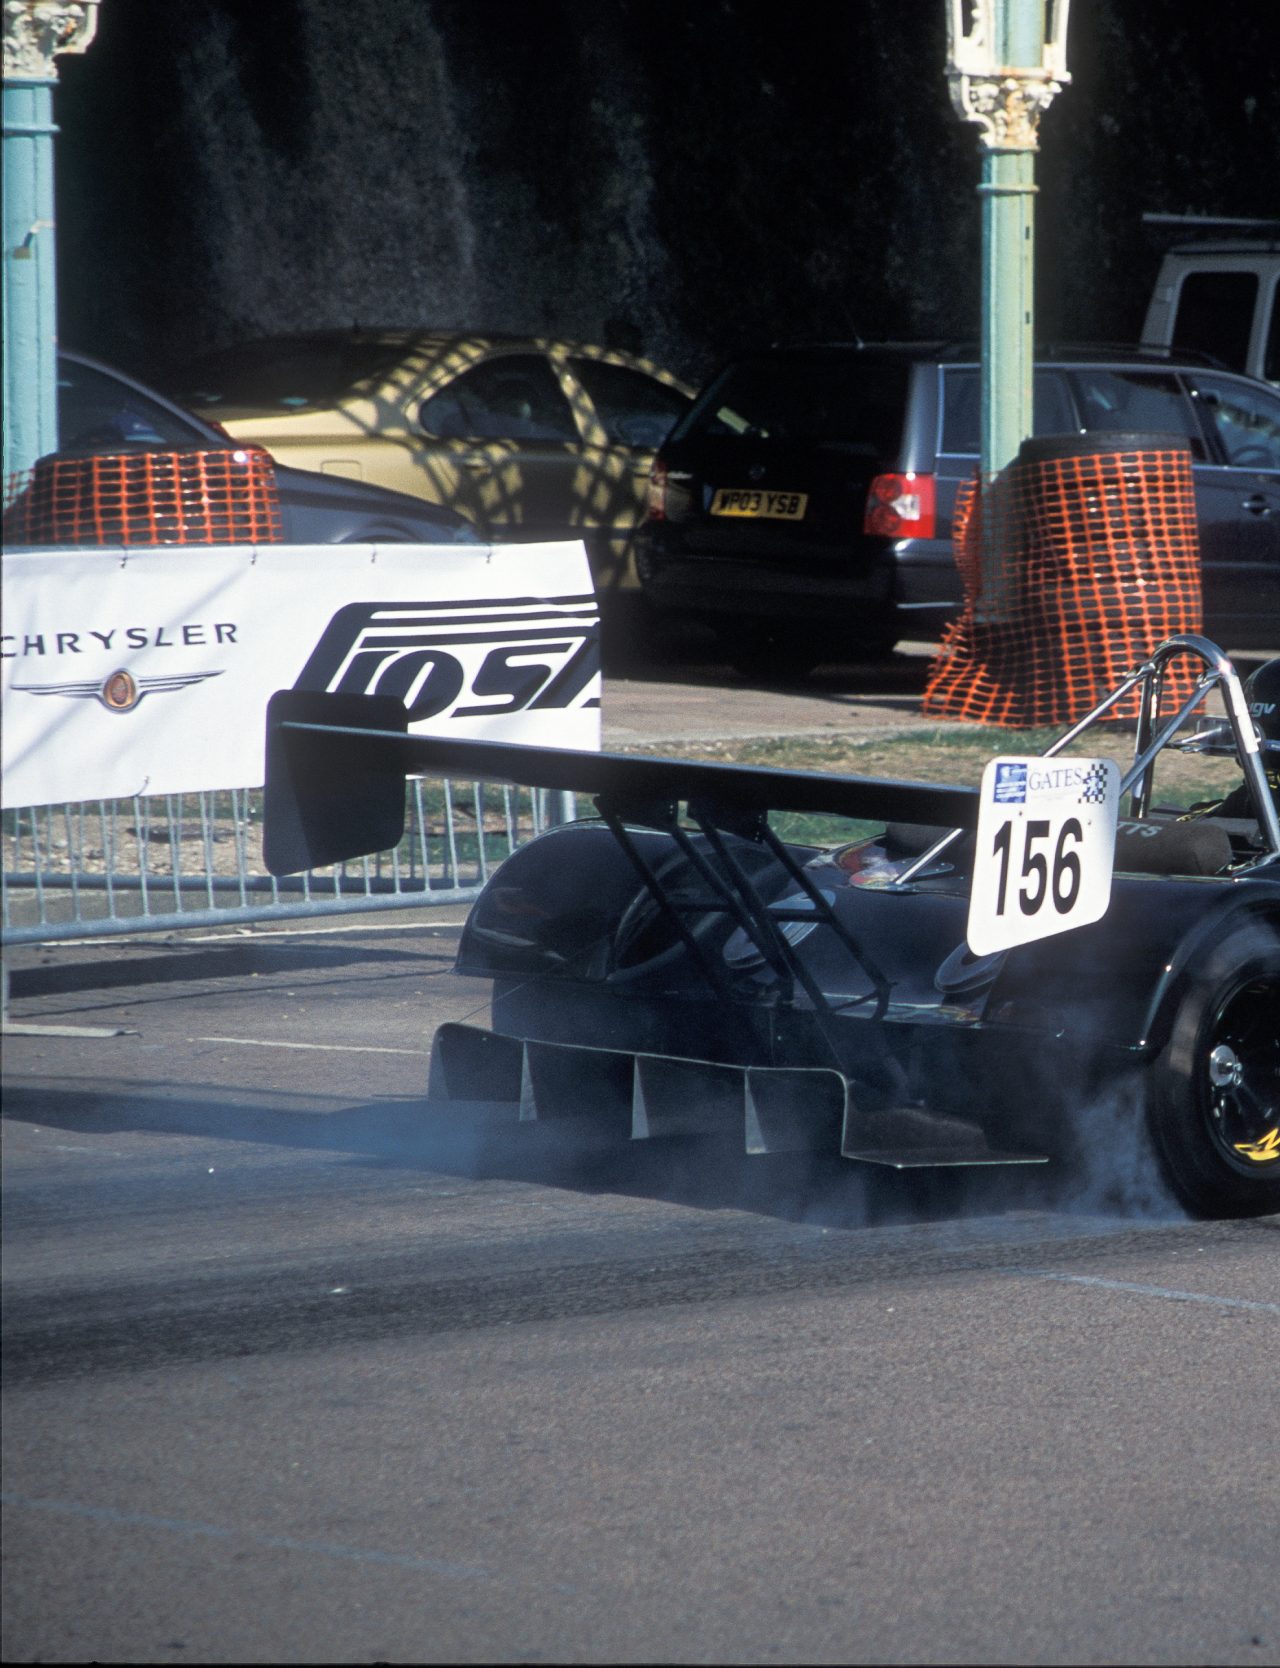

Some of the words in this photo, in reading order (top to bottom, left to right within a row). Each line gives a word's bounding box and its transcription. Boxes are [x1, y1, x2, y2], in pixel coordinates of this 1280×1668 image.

[767, 494, 801, 514] YSB
[1, 622, 239, 657] CHRYSLER
[1028, 768, 1083, 790] GATES
[992, 818, 1083, 915] 156
